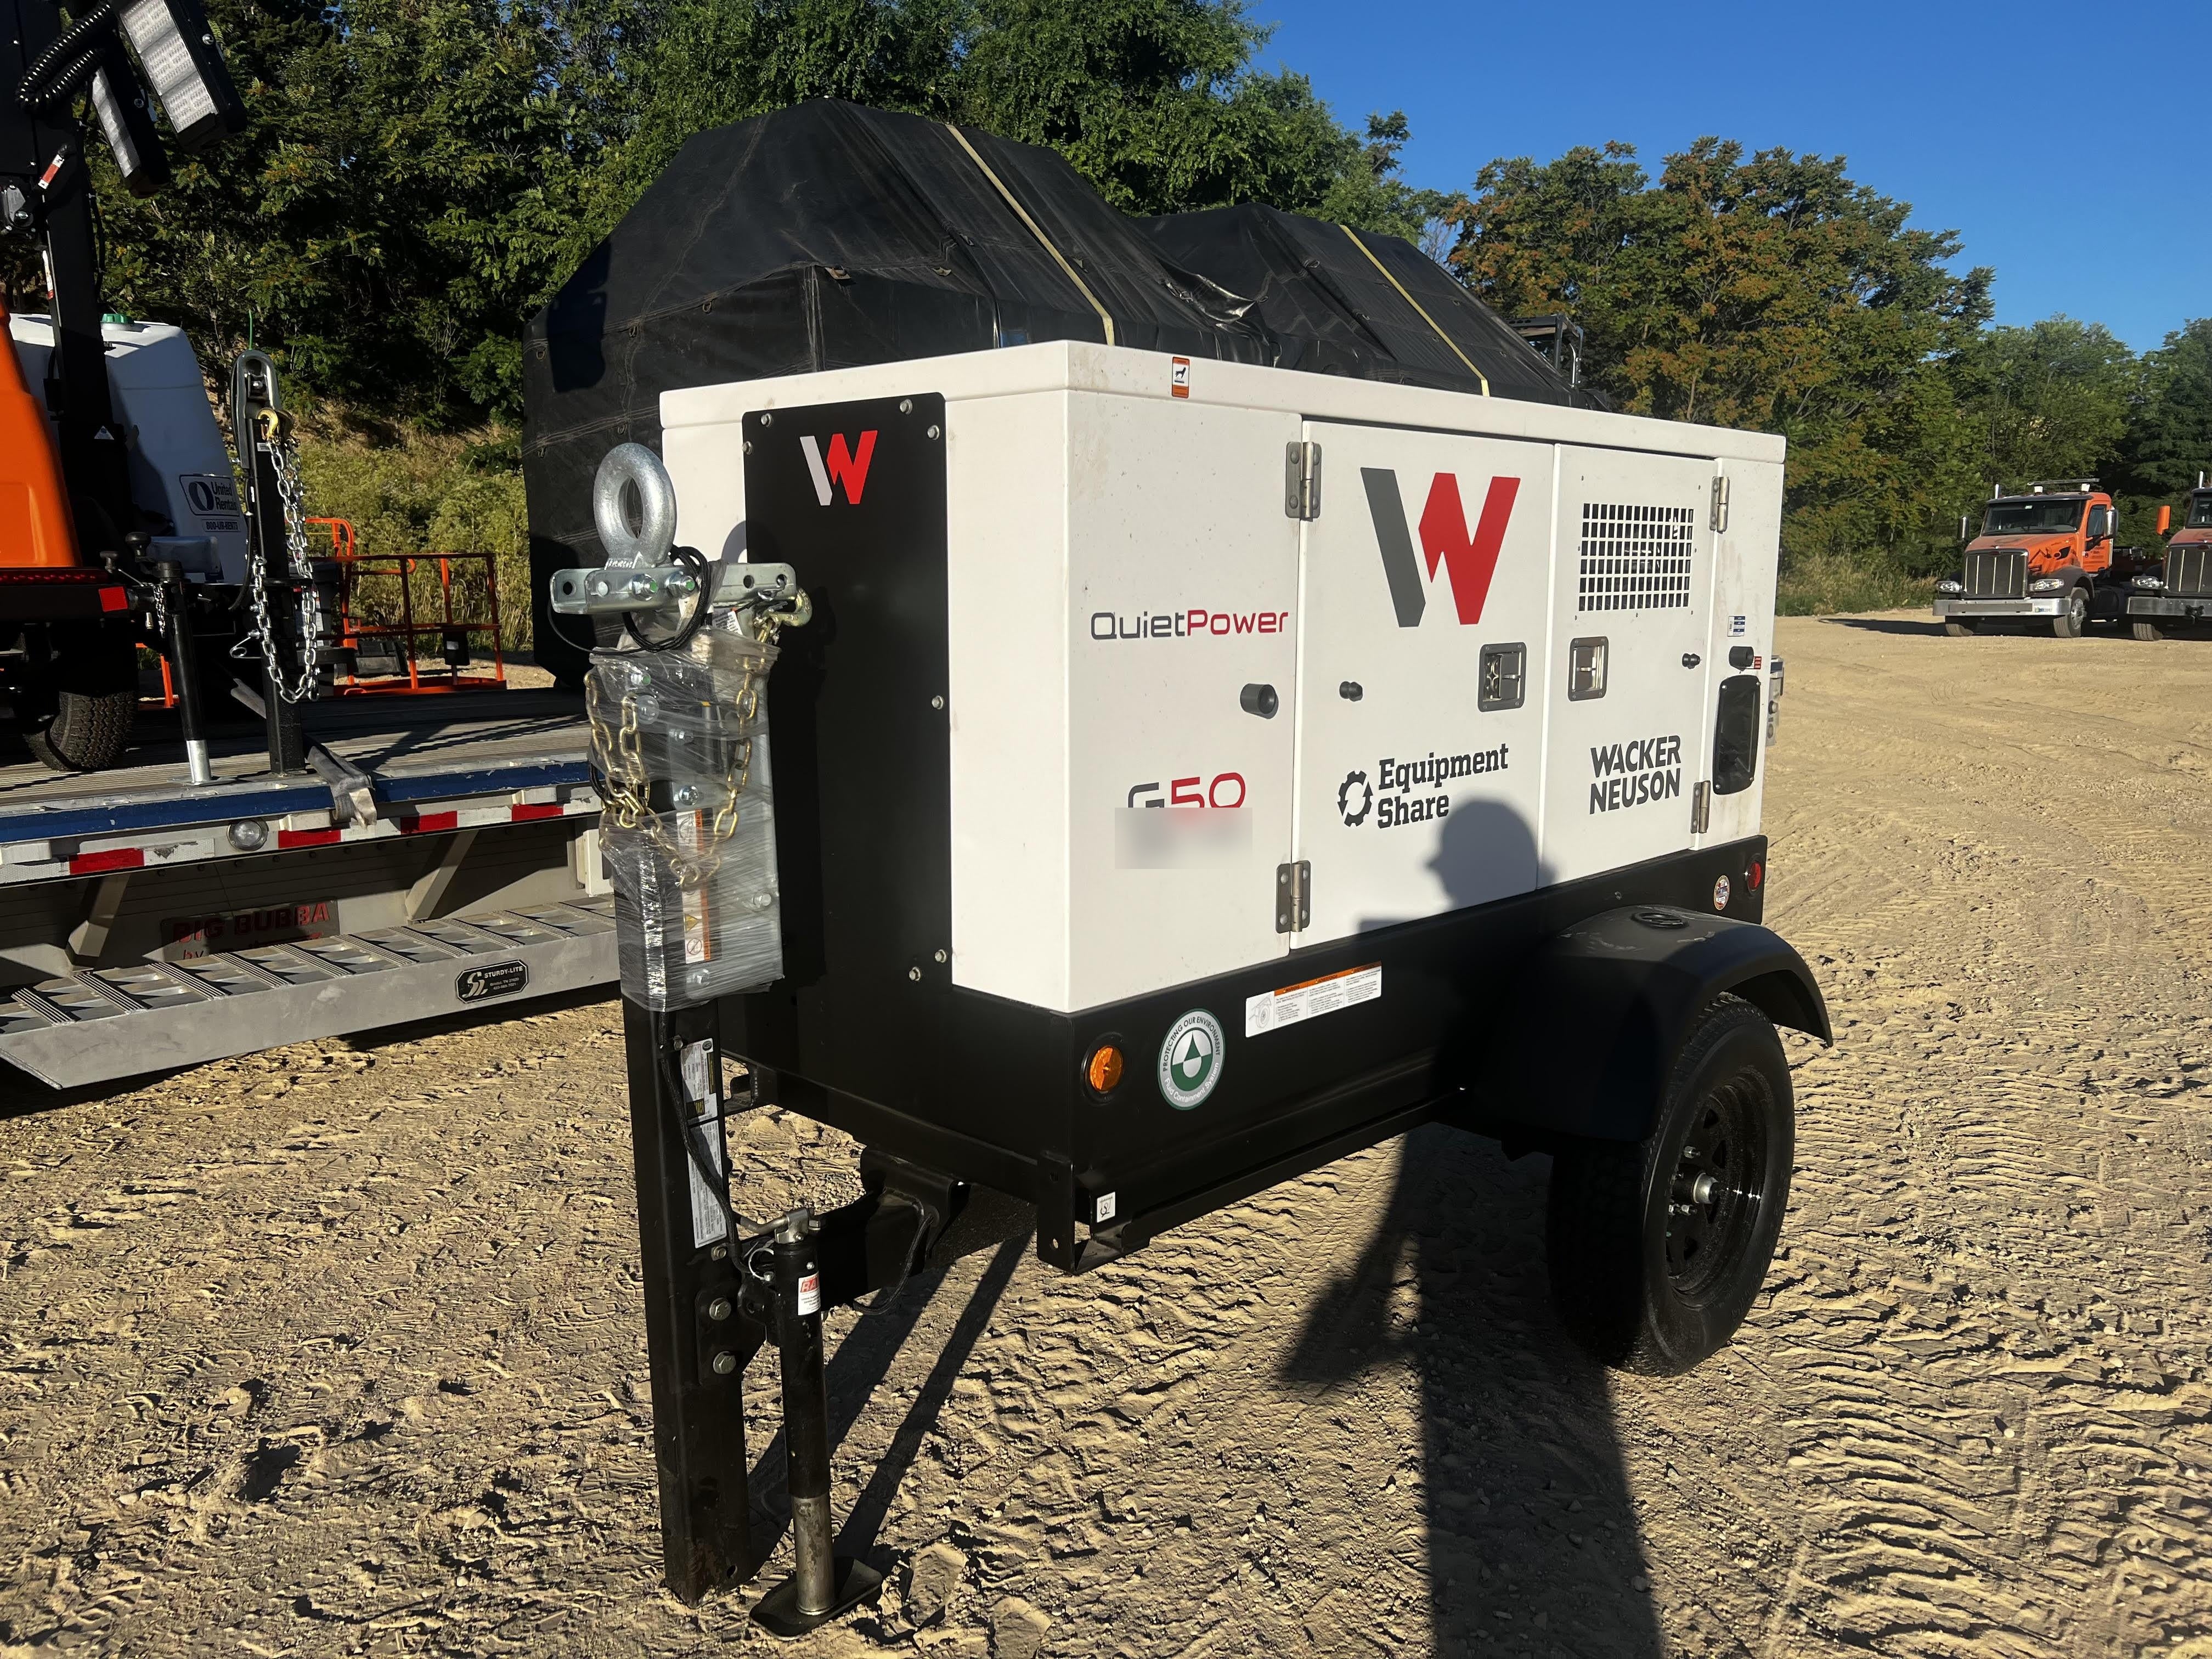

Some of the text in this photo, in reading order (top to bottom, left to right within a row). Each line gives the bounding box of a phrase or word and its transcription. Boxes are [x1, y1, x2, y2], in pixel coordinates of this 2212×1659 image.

[211, 481, 232, 496] United
[1091, 610, 1288, 640] QuietPower
[1378, 743, 1508, 794] Equipment
[1590, 735, 1681, 778] WACKER
[1128, 772, 1246, 808] G50
[1589, 768, 1680, 815] NEUSON
[1378, 795, 1449, 829] Share
[173, 918, 225, 944] BIG
[234, 902, 330, 935] BUBBA
[484, 966, 523, 979] STURDY-LITE
[1163, 1016, 1221, 1071] PROTECTING OUR ENVIRONMENT
[1164, 1062, 1219, 1103] Fluid Containment System
